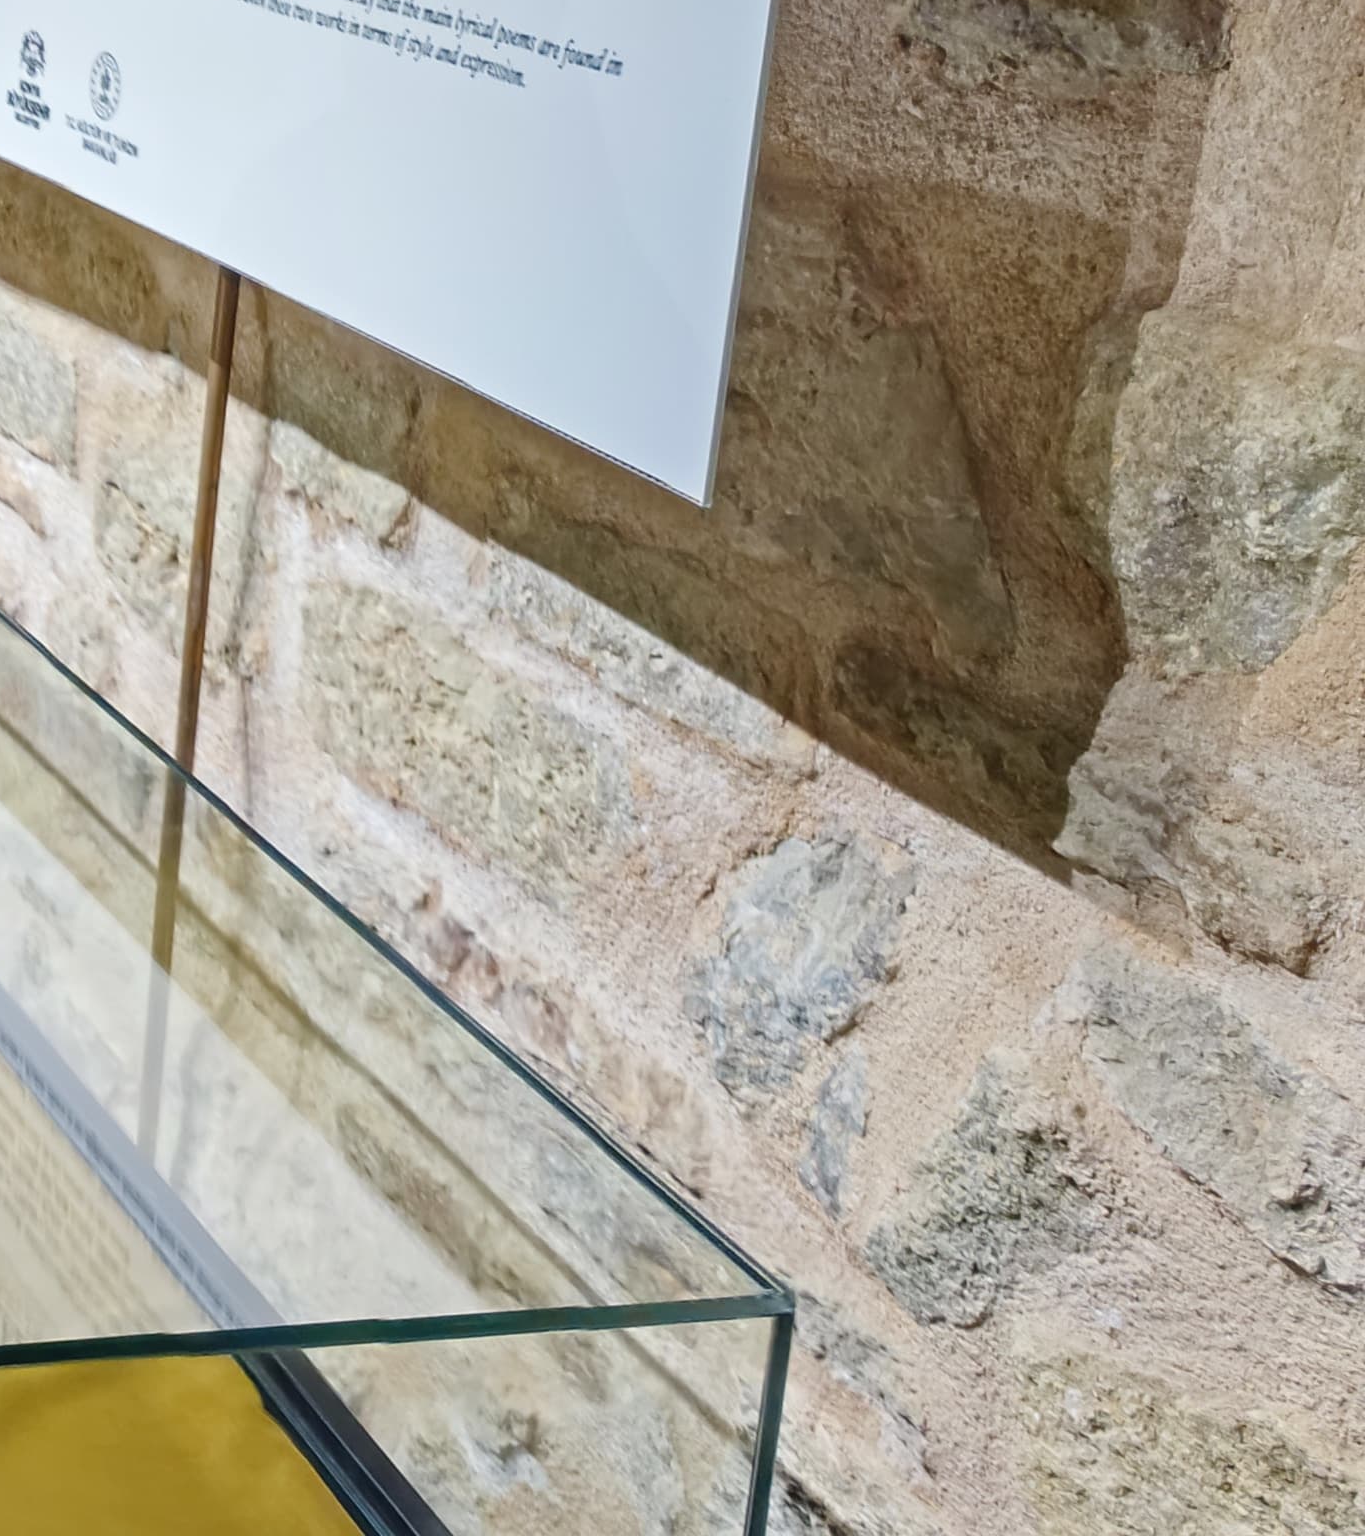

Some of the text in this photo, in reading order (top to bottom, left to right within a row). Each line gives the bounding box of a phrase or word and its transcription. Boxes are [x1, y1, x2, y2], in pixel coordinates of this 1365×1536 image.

[347, 16, 361, 36] in
[361, 23, 392, 46] terms
[406, 29, 434, 61] style
[434, 44, 462, 65] and
[421, 7, 453, 28] main
[493, 20, 536, 51] poems
[536, 39, 561, 67] are
[557, 39, 608, 71] found
[604, 51, 623, 76] in
